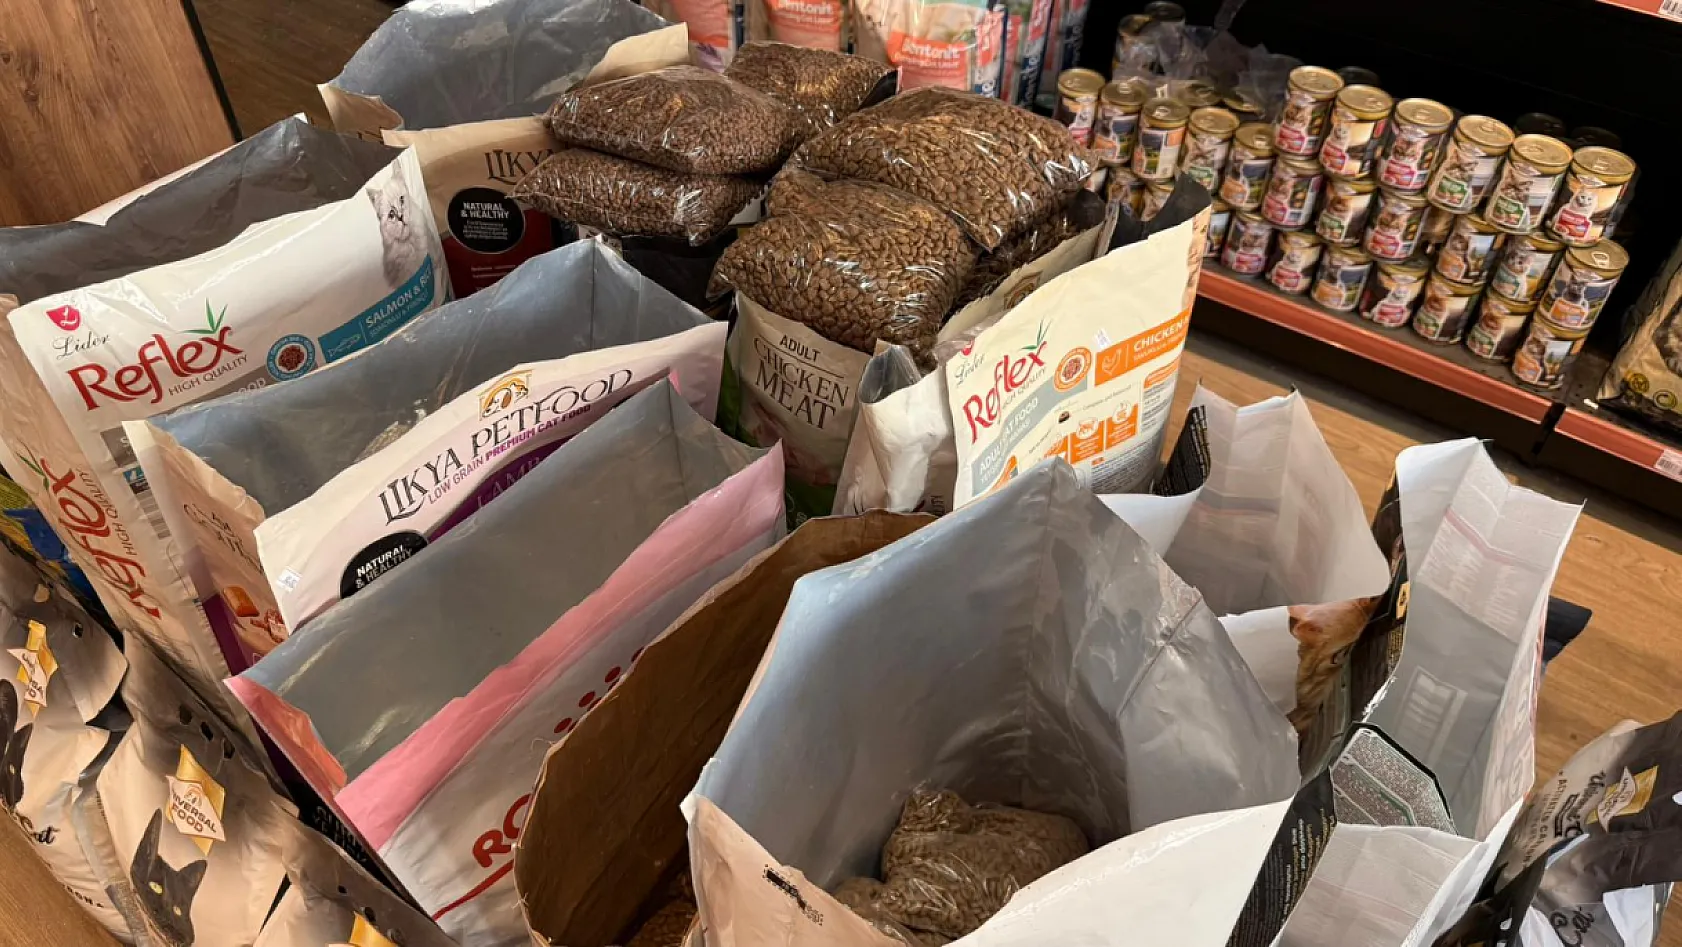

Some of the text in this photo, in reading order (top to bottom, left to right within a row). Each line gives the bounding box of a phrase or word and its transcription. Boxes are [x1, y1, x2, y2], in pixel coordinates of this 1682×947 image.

[484, 149, 553, 185] LIKY
[460, 210, 509, 219] & HEALTHY
[463, 202, 504, 211] NATURAL
[366, 290, 413, 328] SALMON
[51, 330, 110, 361] Lider
[780, 334, 821, 362] ADULT
[1133, 319, 1183, 352] CHICKEN
[67, 326, 244, 412] Reflex
[168, 378, 201, 397] HIGH
[202, 354, 248, 383] QUALITY
[753, 337, 849, 407] CHICKEN
[755, 359, 837, 430] MEAT
[963, 340, 1047, 445] Reflex
[378, 369, 634, 526] LIKYA PETFOOD
[427, 404, 592, 505] LOW GRAIN PREMIUM CAT FOOD
[76, 463, 138, 557] HIGH QUALITY
[355, 548, 413, 589] & HEALTHY
[357, 545, 404, 578] NATURAL
[172, 801, 204, 833] FOOD
